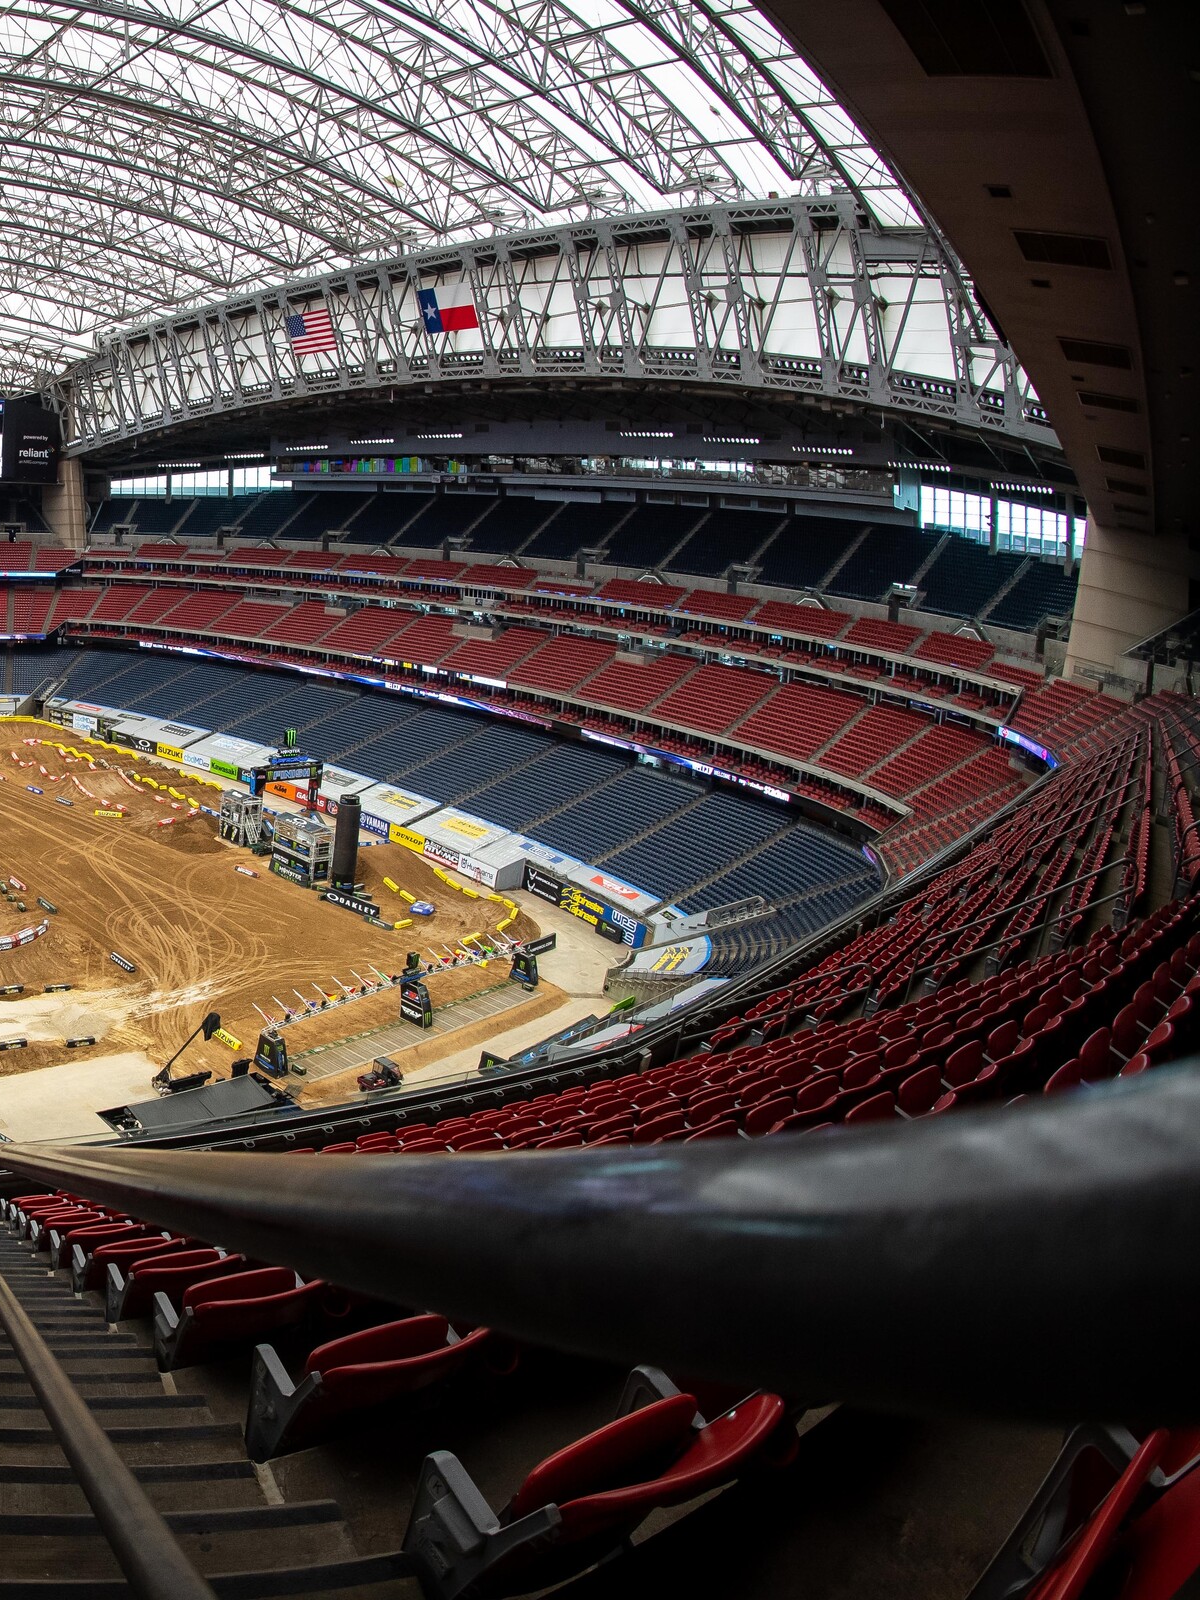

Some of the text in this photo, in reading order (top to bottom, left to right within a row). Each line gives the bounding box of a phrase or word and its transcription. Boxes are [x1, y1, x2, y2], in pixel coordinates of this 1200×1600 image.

[19, 449, 49, 458] reliant
[158, 746, 183, 759] SUZUKI
[211, 762, 237, 777] Kawasaki
[273, 768, 311, 780] FINISH
[714, 769, 730, 780] WELCOME
[274, 785, 287, 793] KTM
[364, 815, 388, 833] YAMAHA
[395, 832, 423, 846] DUNLOP
[279, 866, 302, 881] MONSTER
[535, 876, 558, 889] AIRFORCE.COM
[533, 887, 556, 901] AIRFORCE.COM
[339, 898, 376, 915] OAKLEY
[612, 910, 637, 932] WPS
[115, 958, 130, 970] OAKLEY
